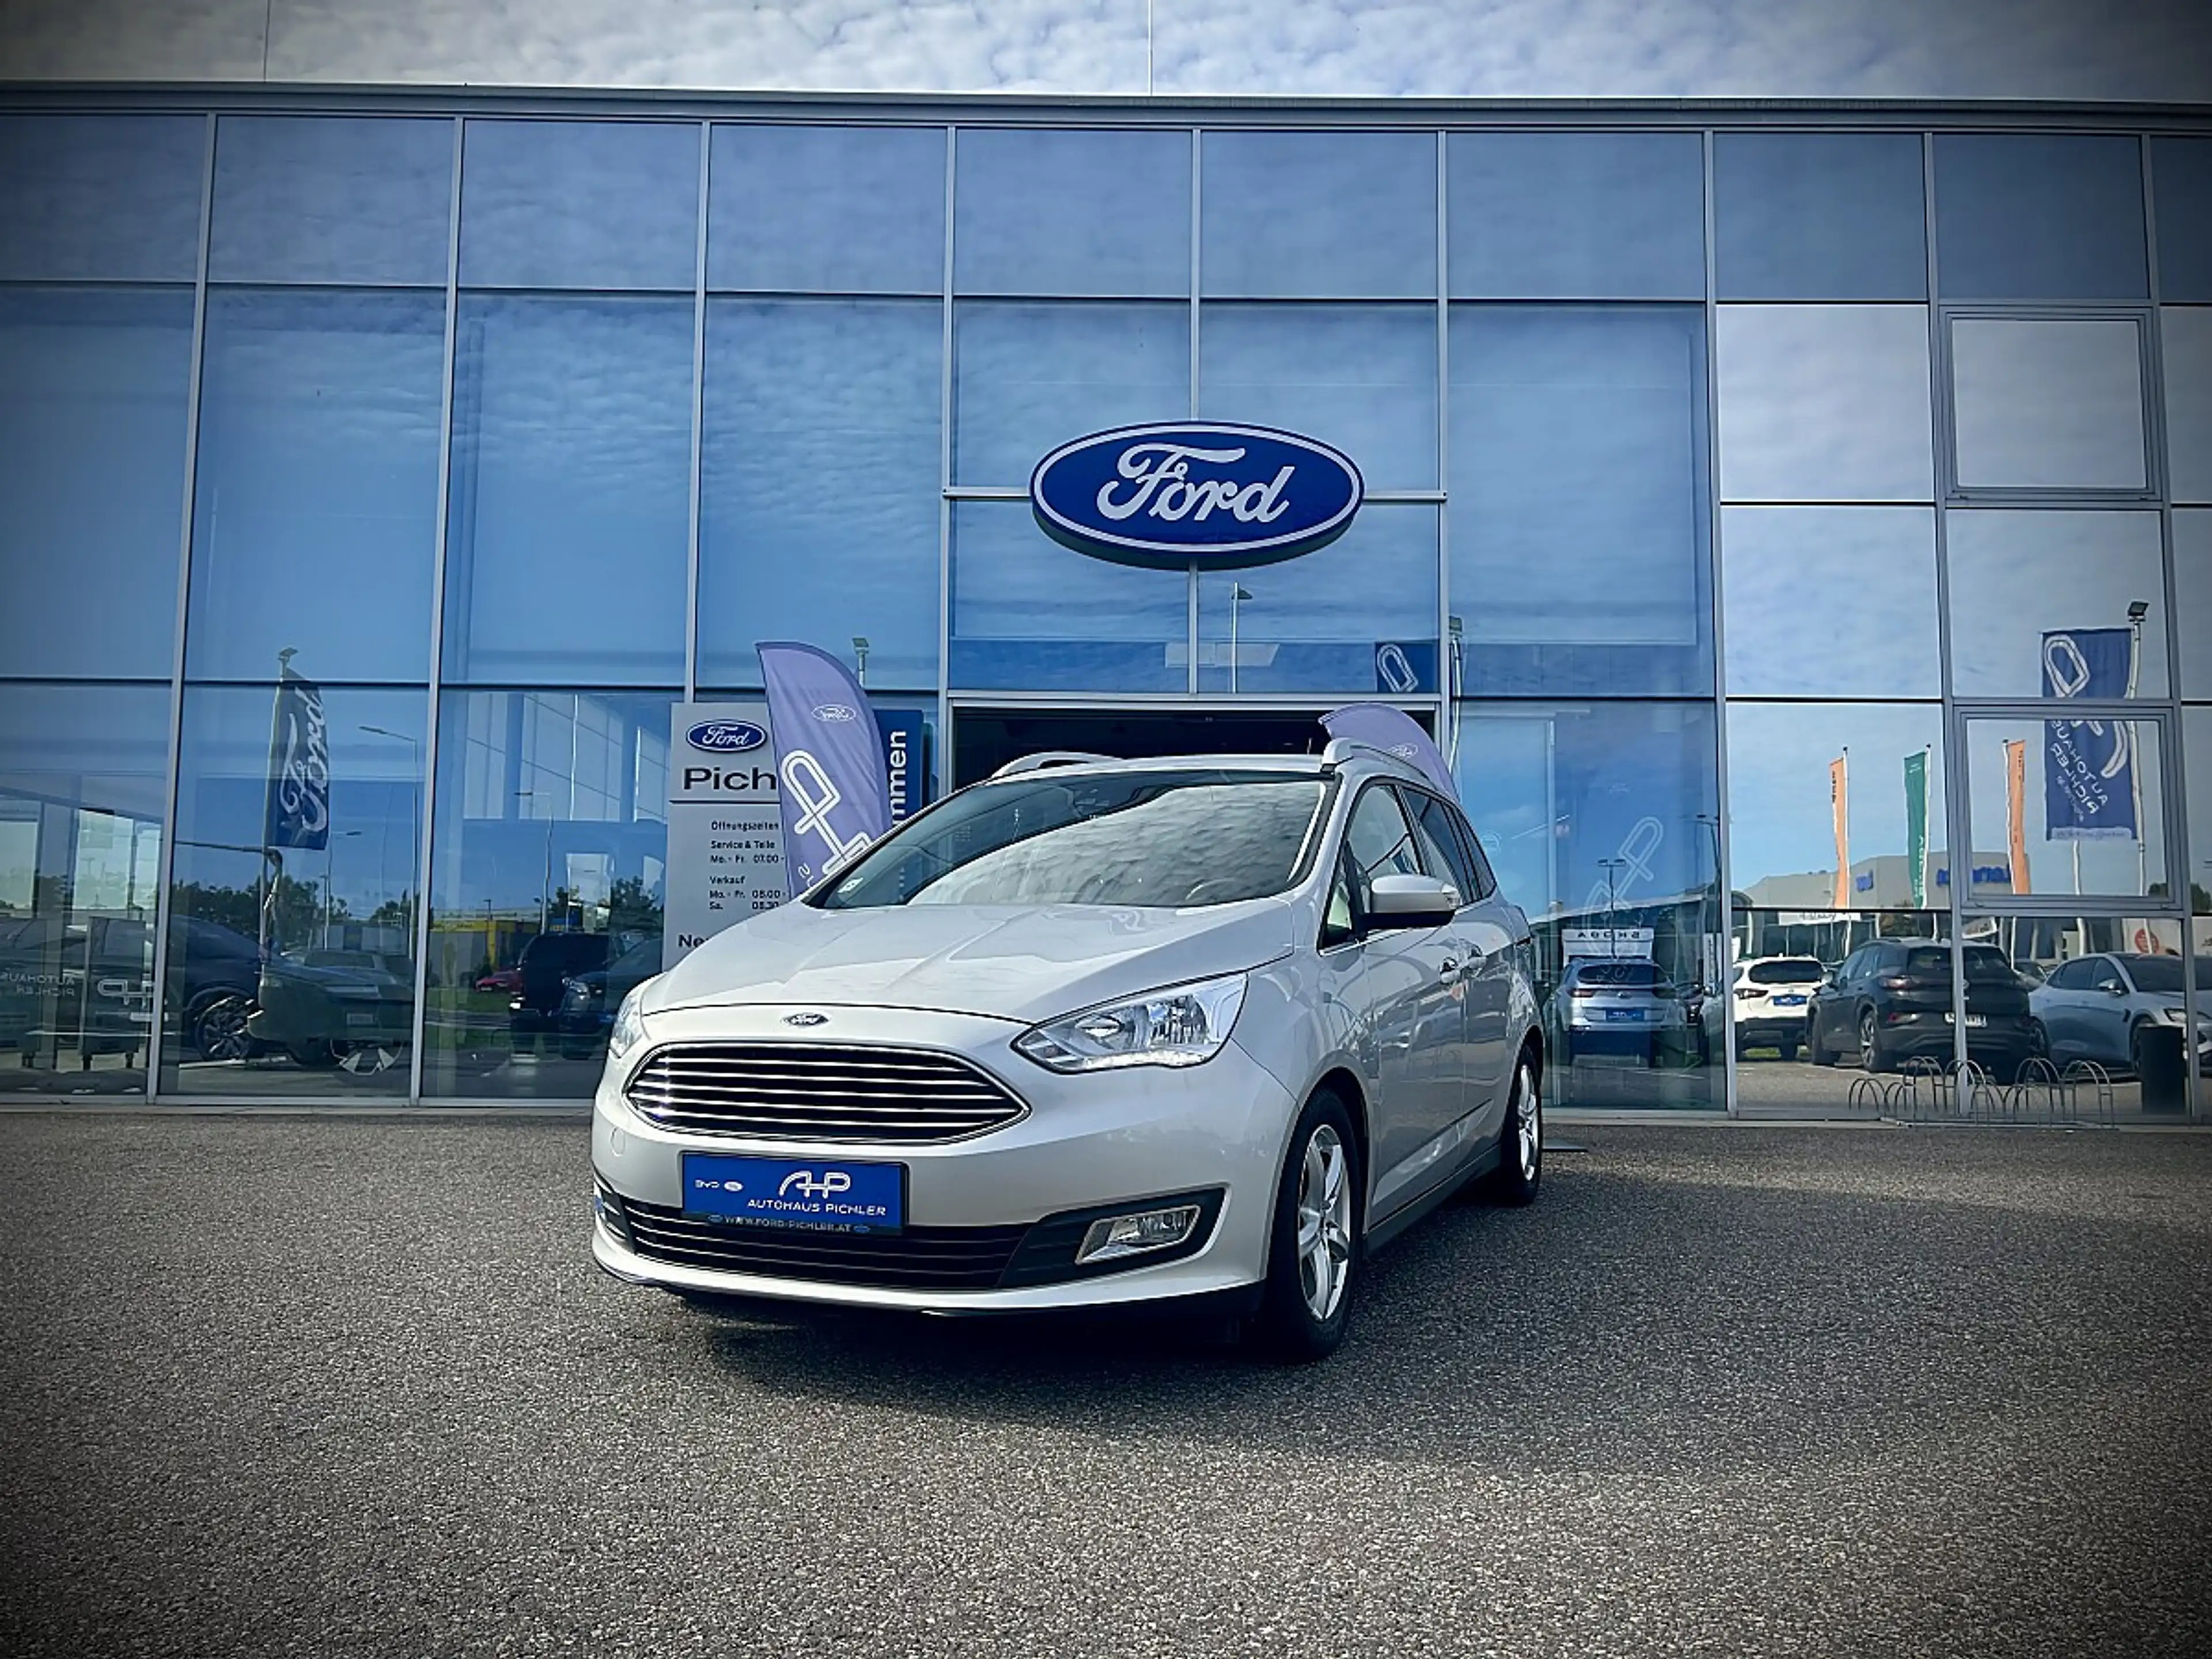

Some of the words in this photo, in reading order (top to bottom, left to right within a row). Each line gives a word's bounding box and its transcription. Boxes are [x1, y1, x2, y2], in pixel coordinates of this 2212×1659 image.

[1097, 443, 1295, 522] Ford
[702, 726, 749, 745] Ford
[280, 687, 328, 831] Ford
[684, 767, 777, 790] Pich
[711, 840, 743, 849] Service
[754, 840, 775, 849] Teile
[709, 875, 745, 884] Verkauf
[748, 1199, 821, 1213] AUTOHAUS
[825, 1203, 886, 1216] PICHLER
